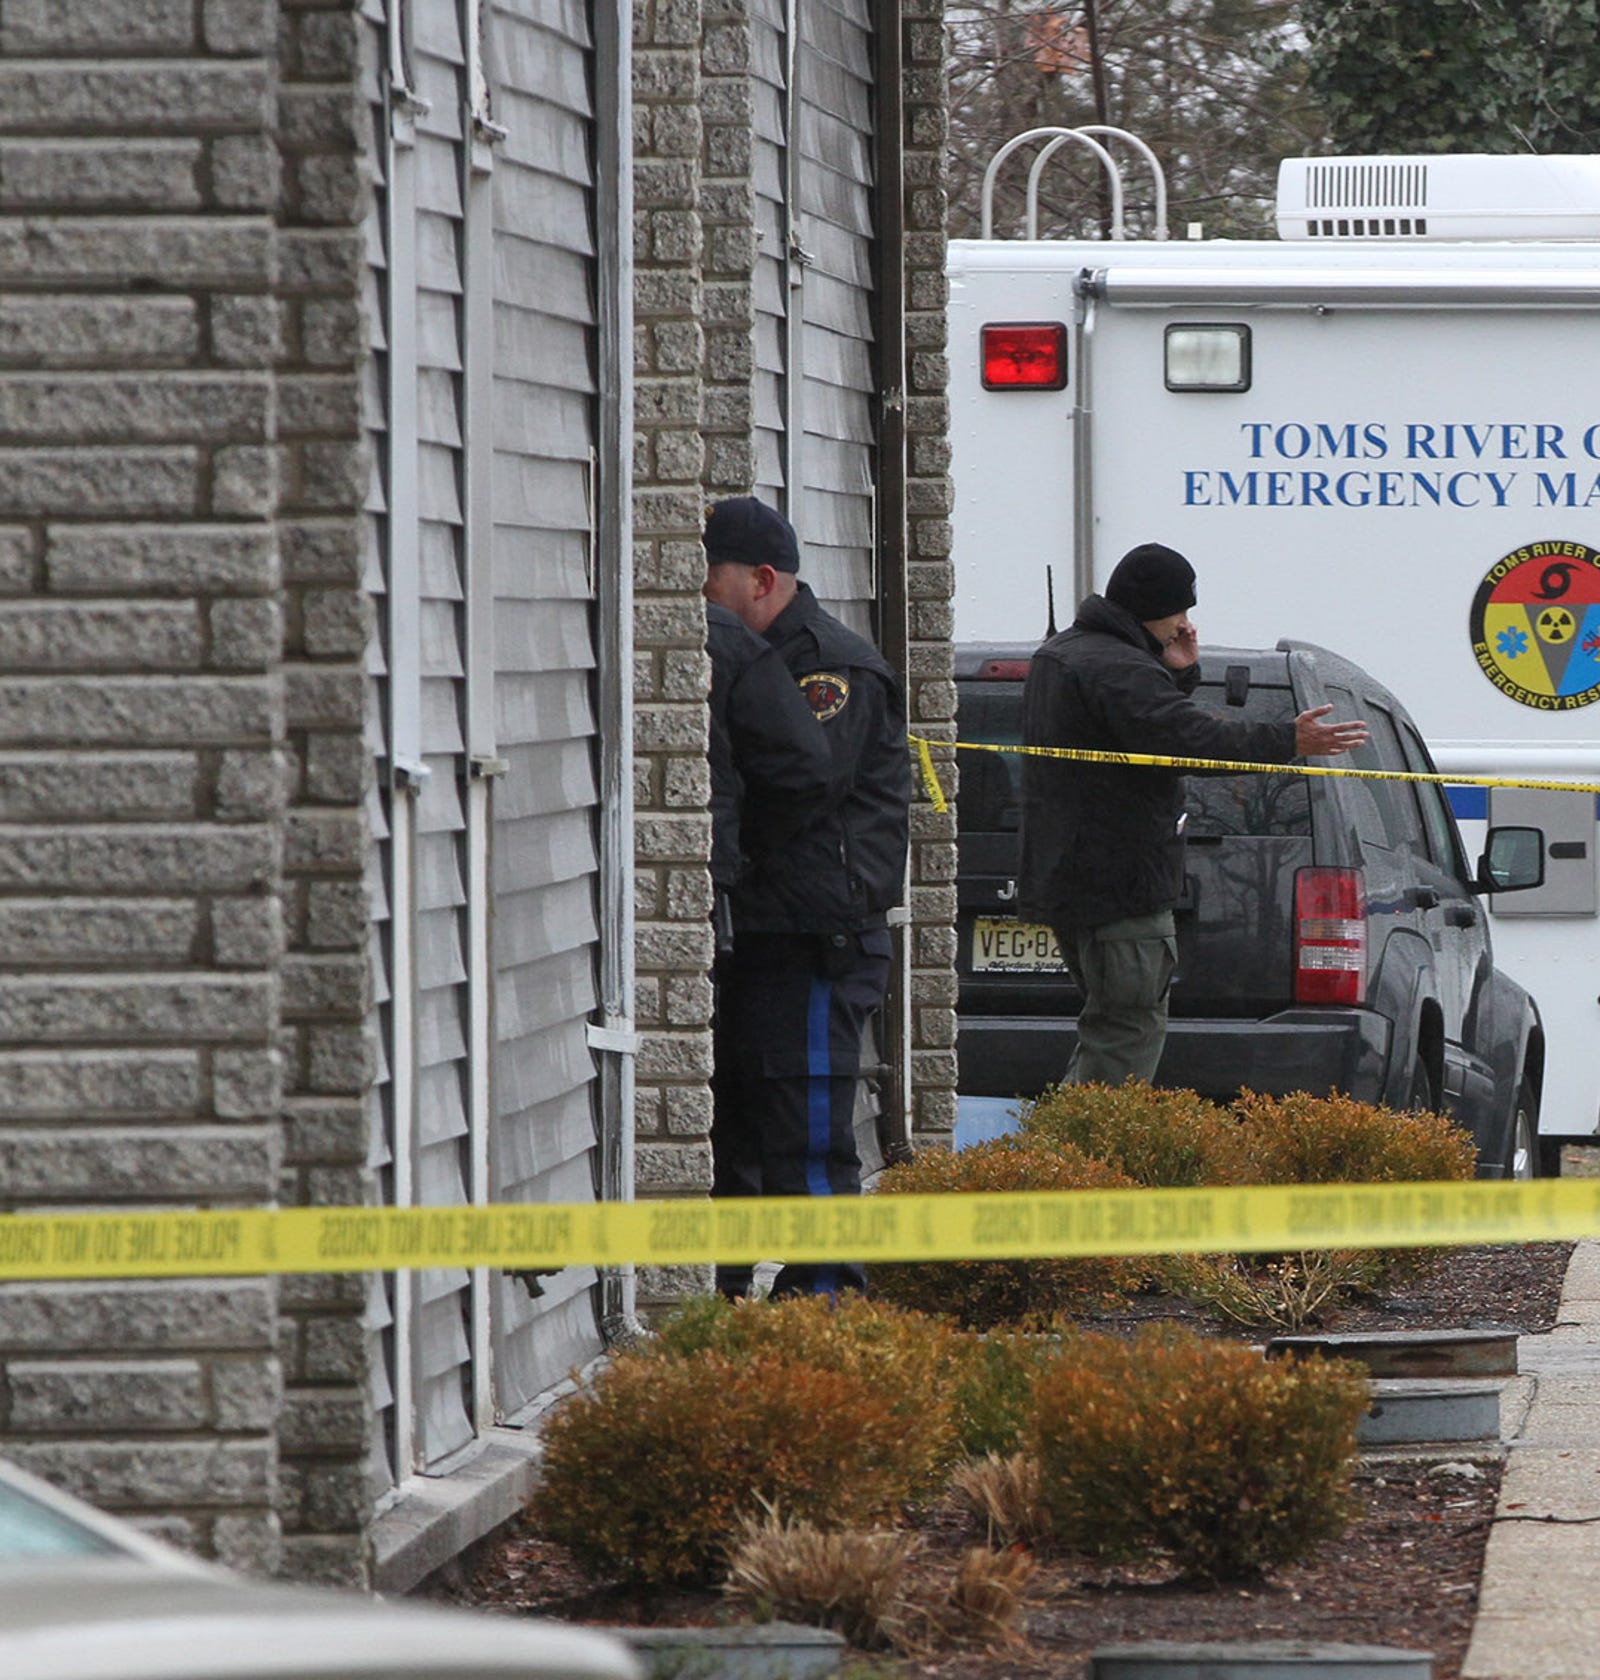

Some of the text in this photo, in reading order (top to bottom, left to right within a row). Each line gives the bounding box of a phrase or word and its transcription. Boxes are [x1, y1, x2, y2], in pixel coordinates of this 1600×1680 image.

[1241, 423, 1388, 458] TOMS
[1405, 424, 1568, 459] RIVER
[1182, 471, 1518, 507] EMERGENCY
[1485, 549, 1530, 585] TOMS
[1532, 542, 1587, 559] RIVER
[1473, 641, 1562, 709] EMERGENCY
[981, 930, 1064, 958] VEG 82
